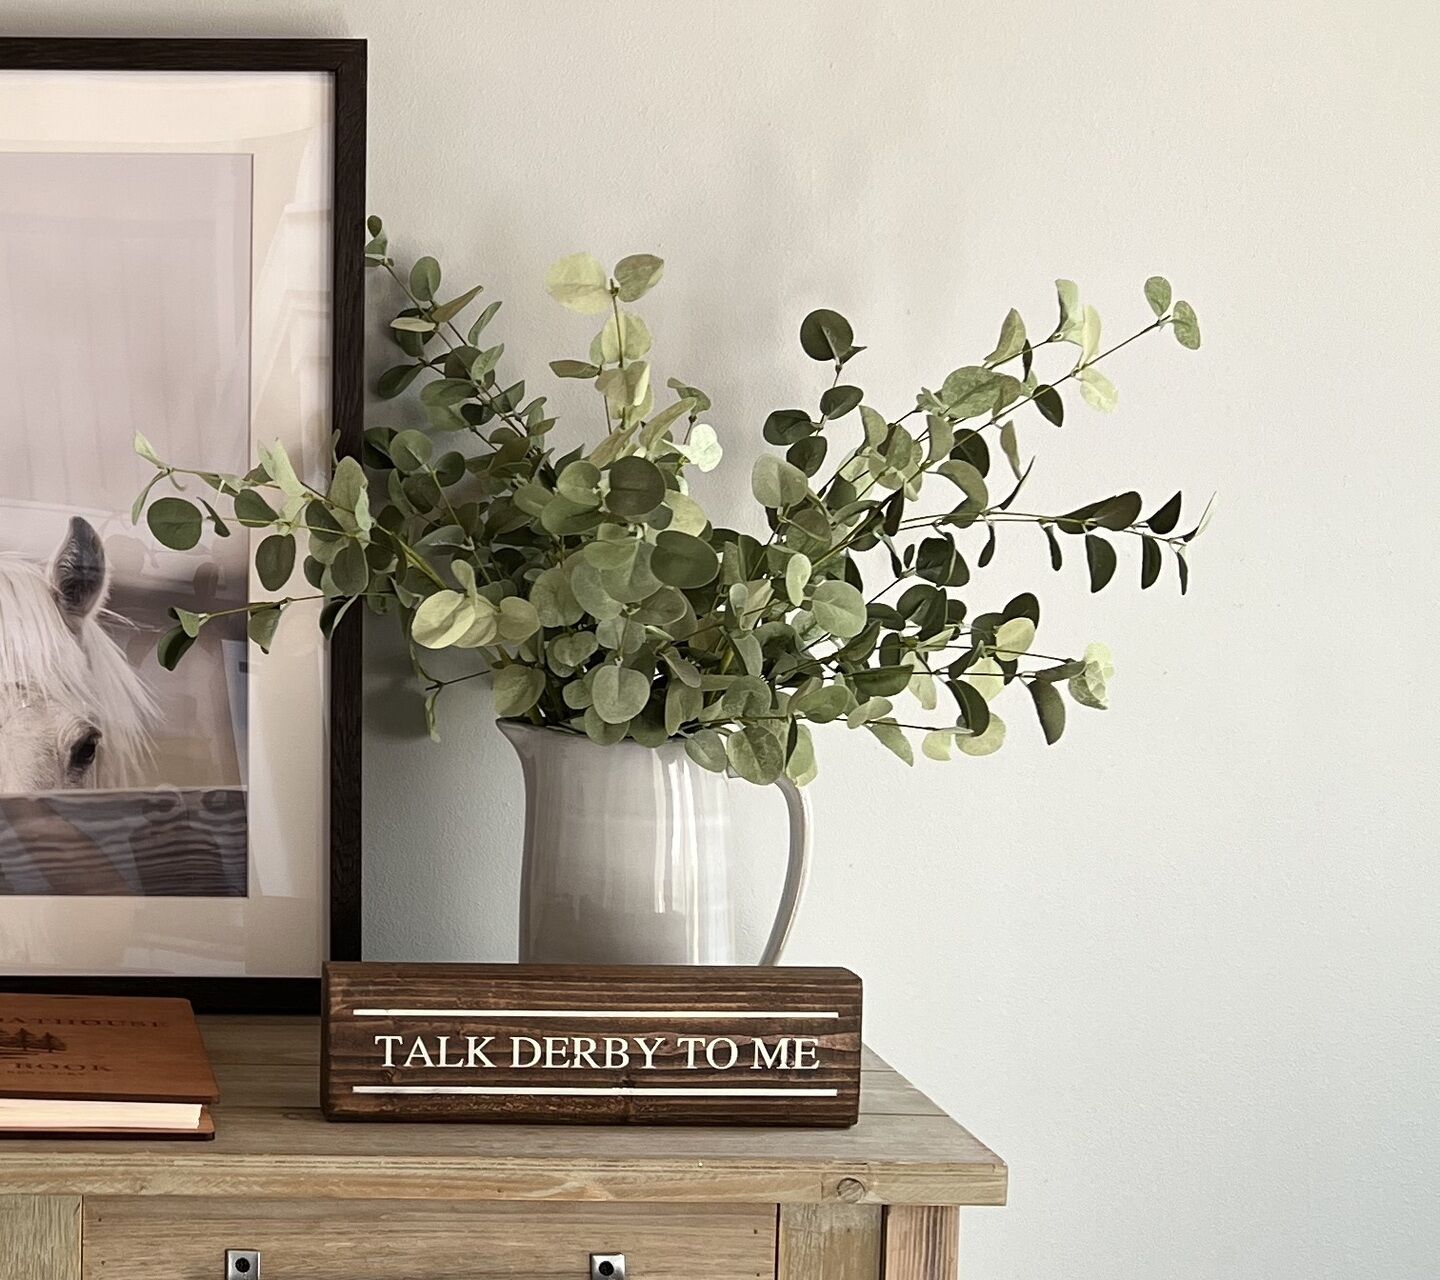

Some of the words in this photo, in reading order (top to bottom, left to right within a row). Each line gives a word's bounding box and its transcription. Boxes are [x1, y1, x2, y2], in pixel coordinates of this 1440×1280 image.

[374, 1034, 500, 1069] TALK
[509, 1035, 666, 1070] DERBY
[676, 1036, 739, 1070] TO
[749, 1037, 821, 1071] ME
[13, 1062, 114, 1073] BOOK
